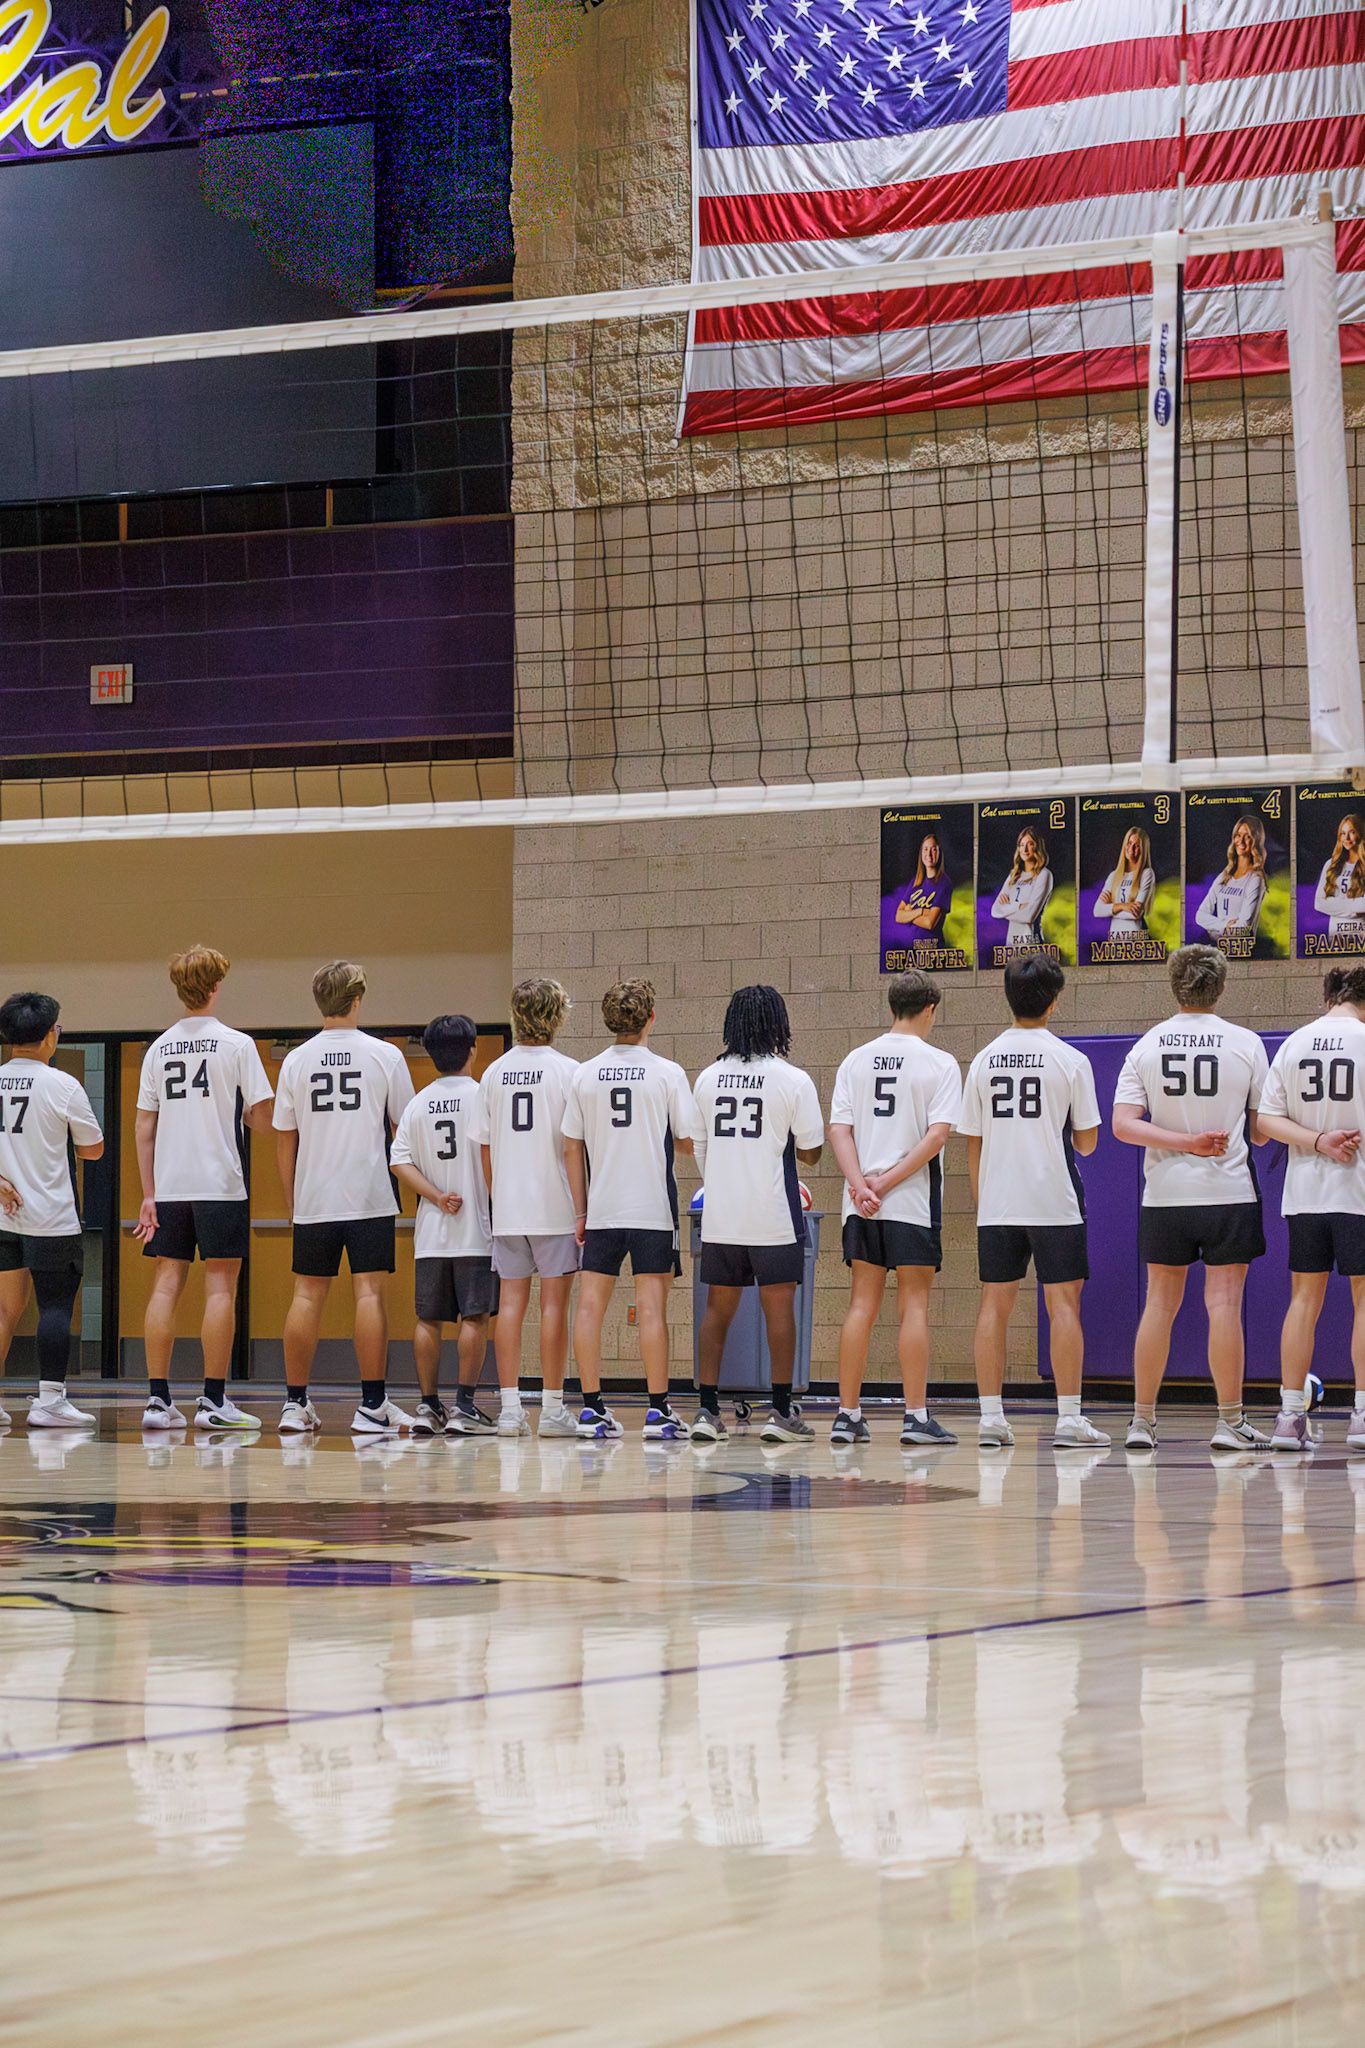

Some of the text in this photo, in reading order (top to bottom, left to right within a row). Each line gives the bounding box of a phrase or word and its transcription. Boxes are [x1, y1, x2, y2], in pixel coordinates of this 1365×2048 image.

[1159, 323, 1169, 387] SPORTS
[98, 671, 126, 697] EXIT
[1188, 793, 1207, 805] Cal
[1299, 788, 1318, 800] Cal
[981, 806, 998, 818] Cal
[1082, 799, 1100, 811] Cal
[1154, 795, 1170, 824] 3
[1261, 789, 1281, 819] 4
[883, 811, 899, 823] Cal
[1050, 800, 1065, 829] 2
[1341, 878, 1348, 894] 5
[909, 888, 936, 909] Cal
[1223, 898, 1230, 916] 4
[1108, 930, 1150, 940] KAYLEIGH
[1222, 926, 1253, 937] AVERY
[1336, 922, 1364, 932] KEIRA
[1091, 940, 1167, 962] MIERSEN
[1217, 936, 1256, 957] SEIF
[885, 949, 968, 970] STAUFFER
[160, 1039, 218, 1059] FELDPAUSCH
[1158, 1033, 1224, 1048] NOSTRANT
[1312, 1037, 1344, 1051] HALL
[321, 1052, 351, 1066] JUDD
[873, 1056, 904, 1070] SNOW
[989, 1054, 1045, 1069] KIMBRELL
[0, 1077, 34, 1090] GUYEN
[164, 1059, 210, 1100] 24
[502, 1070, 543, 1086] BUCHAN
[598, 1067, 646, 1081] GEISTER
[717, 1074, 765, 1089] PITTMAN
[1161, 1053, 1218, 1097] 50
[1298, 1058, 1355, 1102] 30
[310, 1071, 362, 1112] 25
[873, 1076, 897, 1117] 5
[990, 1076, 1041, 1118] 28
[428, 1099, 460, 1114] SAKUI
[512, 1091, 533, 1132] 0
[610, 1087, 632, 1128] 9
[714, 1096, 763, 1138] 23
[434, 1120, 457, 1160] 3
